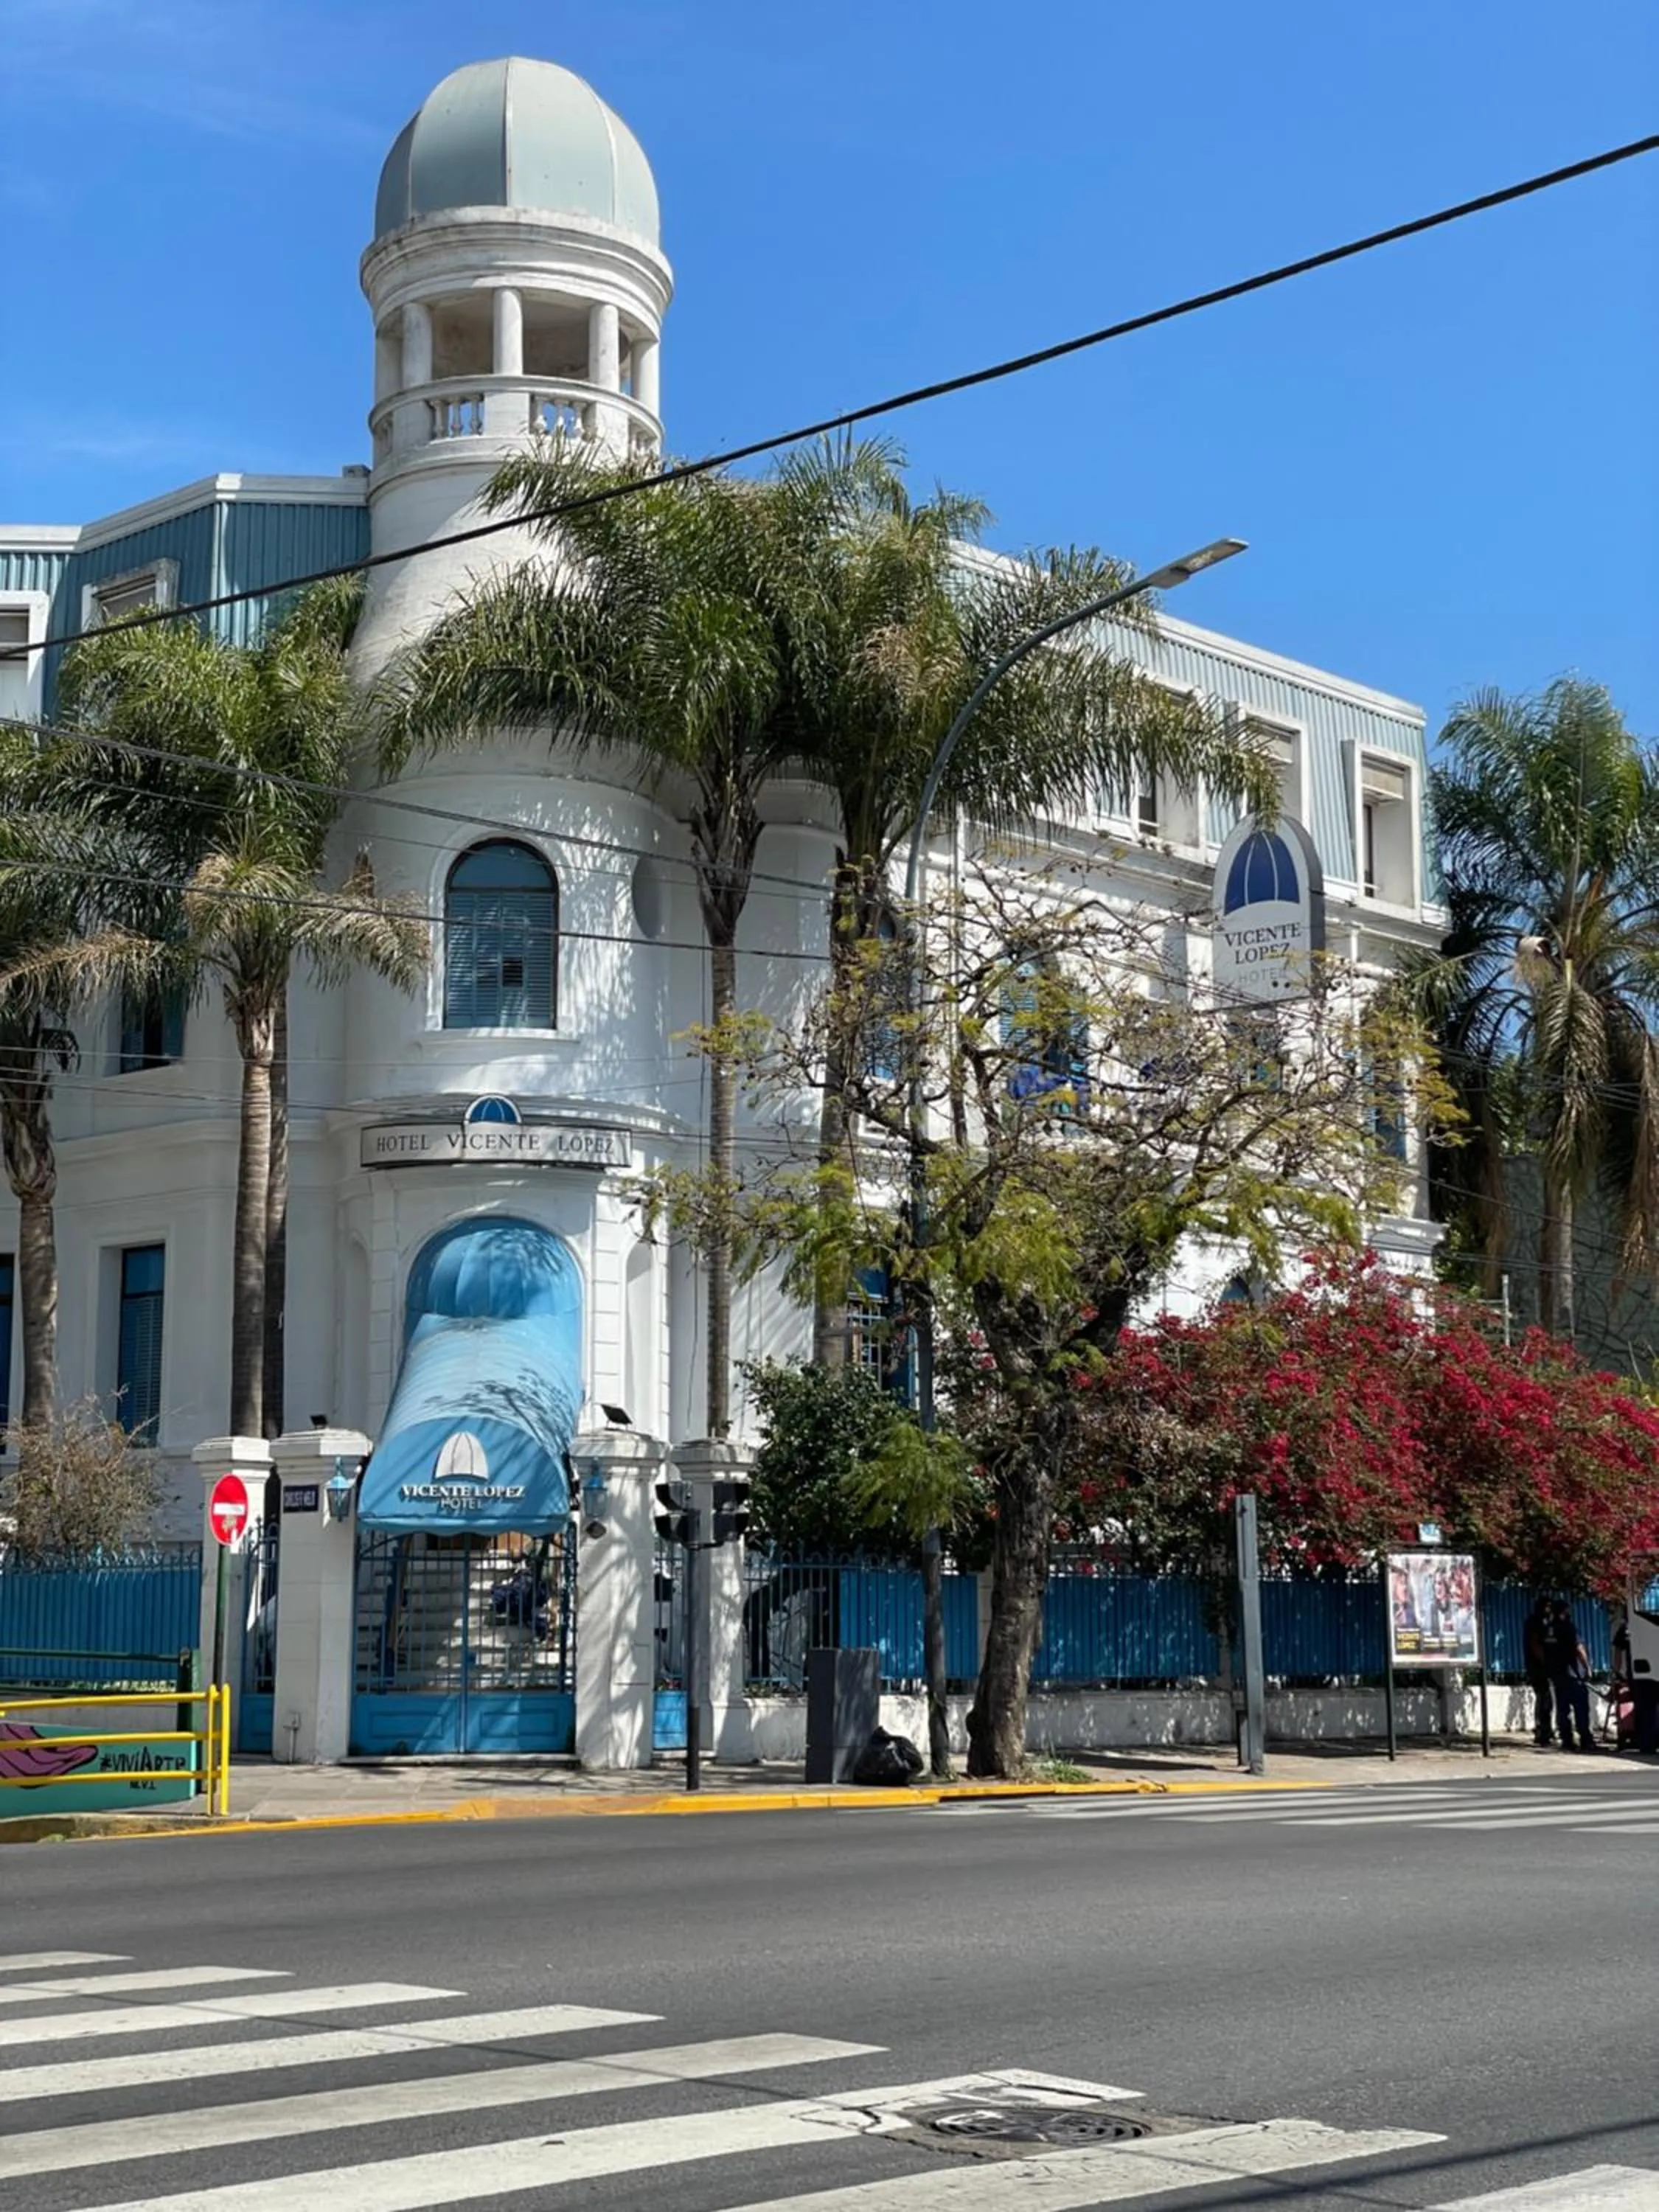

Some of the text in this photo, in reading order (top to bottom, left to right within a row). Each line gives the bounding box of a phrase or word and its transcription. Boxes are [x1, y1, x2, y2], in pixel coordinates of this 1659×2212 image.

[1224, 922, 1301, 947] VICENTE
[1234, 942, 1290, 964] LOPEZ
[377, 1133, 613, 1155] HOTEL VICENTE LOPEZ
[401, 1484, 525, 1498] VICENTE LOPEZ
[440, 1498, 482, 1509] HOTEL
